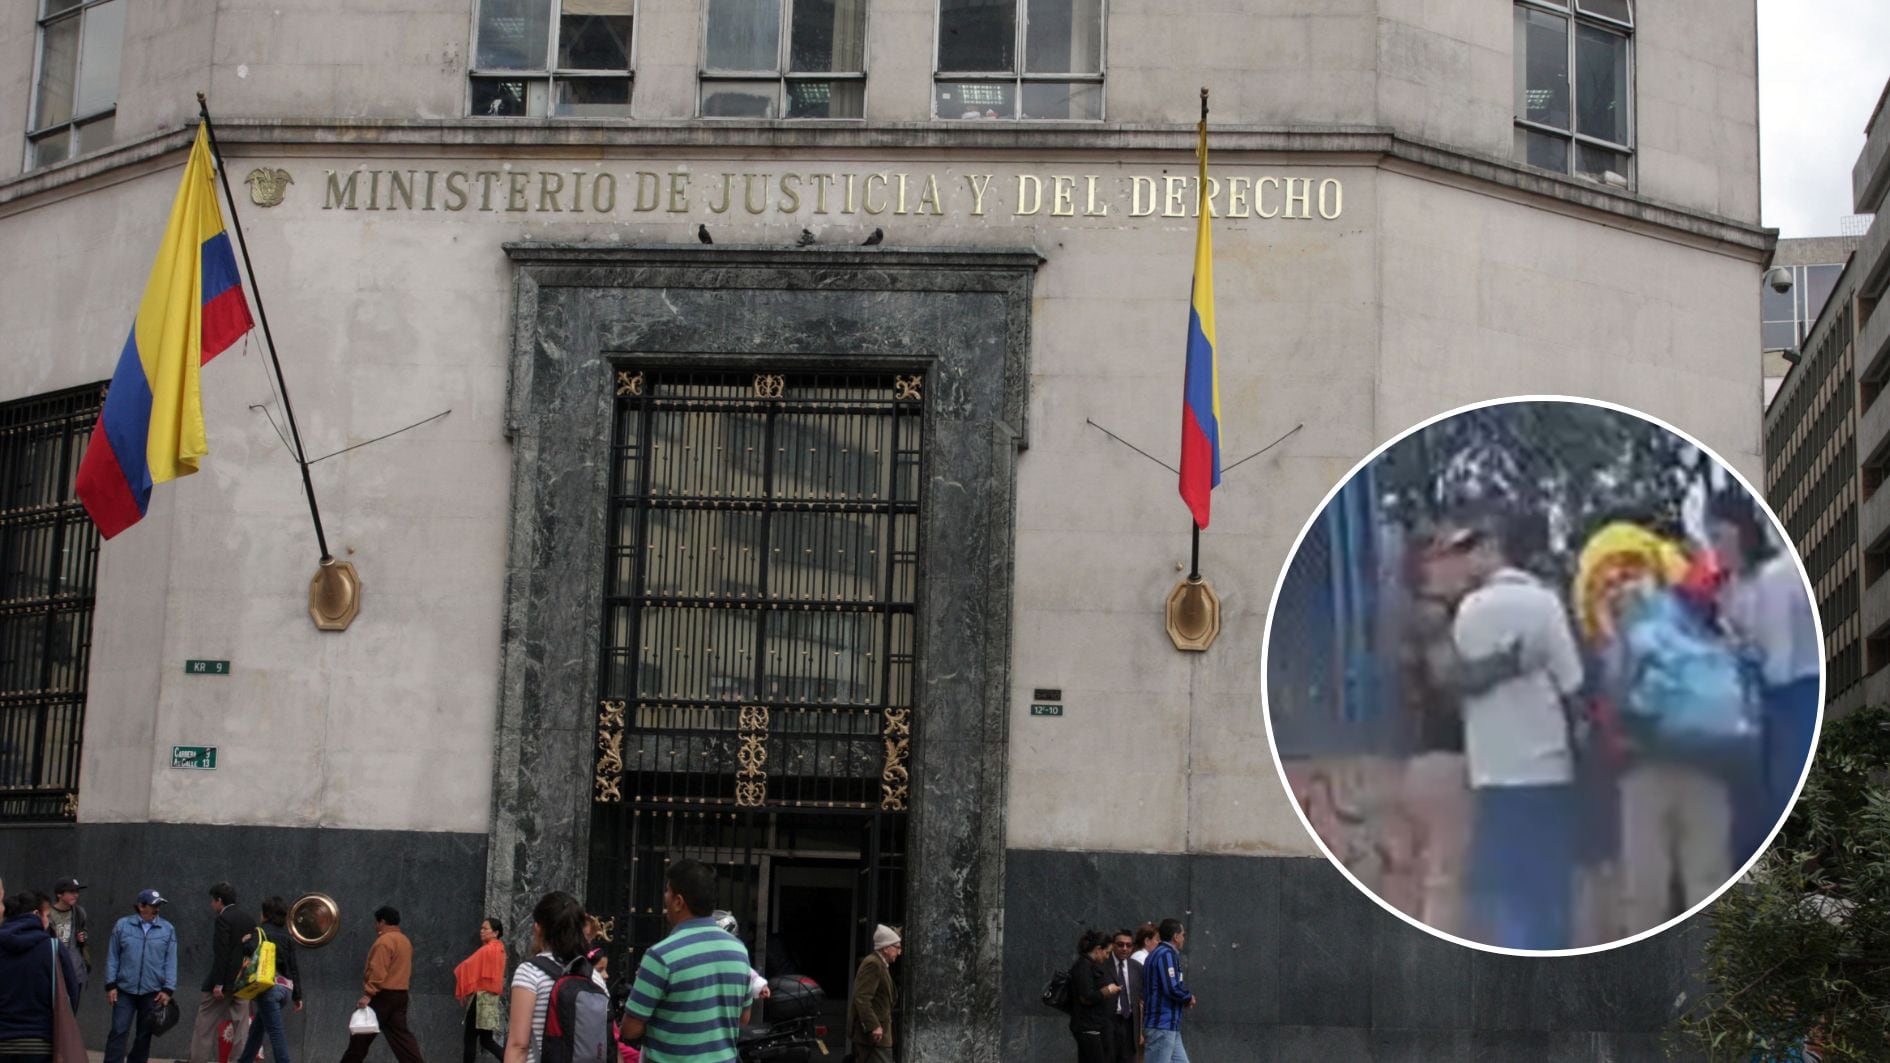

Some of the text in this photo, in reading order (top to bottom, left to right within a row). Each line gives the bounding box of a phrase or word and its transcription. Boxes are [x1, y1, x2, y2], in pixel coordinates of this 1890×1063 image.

[321, 168, 1344, 220] MINISTERIO DE JUSTICIA Y DEL DERECHO
[194, 662, 223, 673] KR 9
[202, 759, 210, 768] 13
